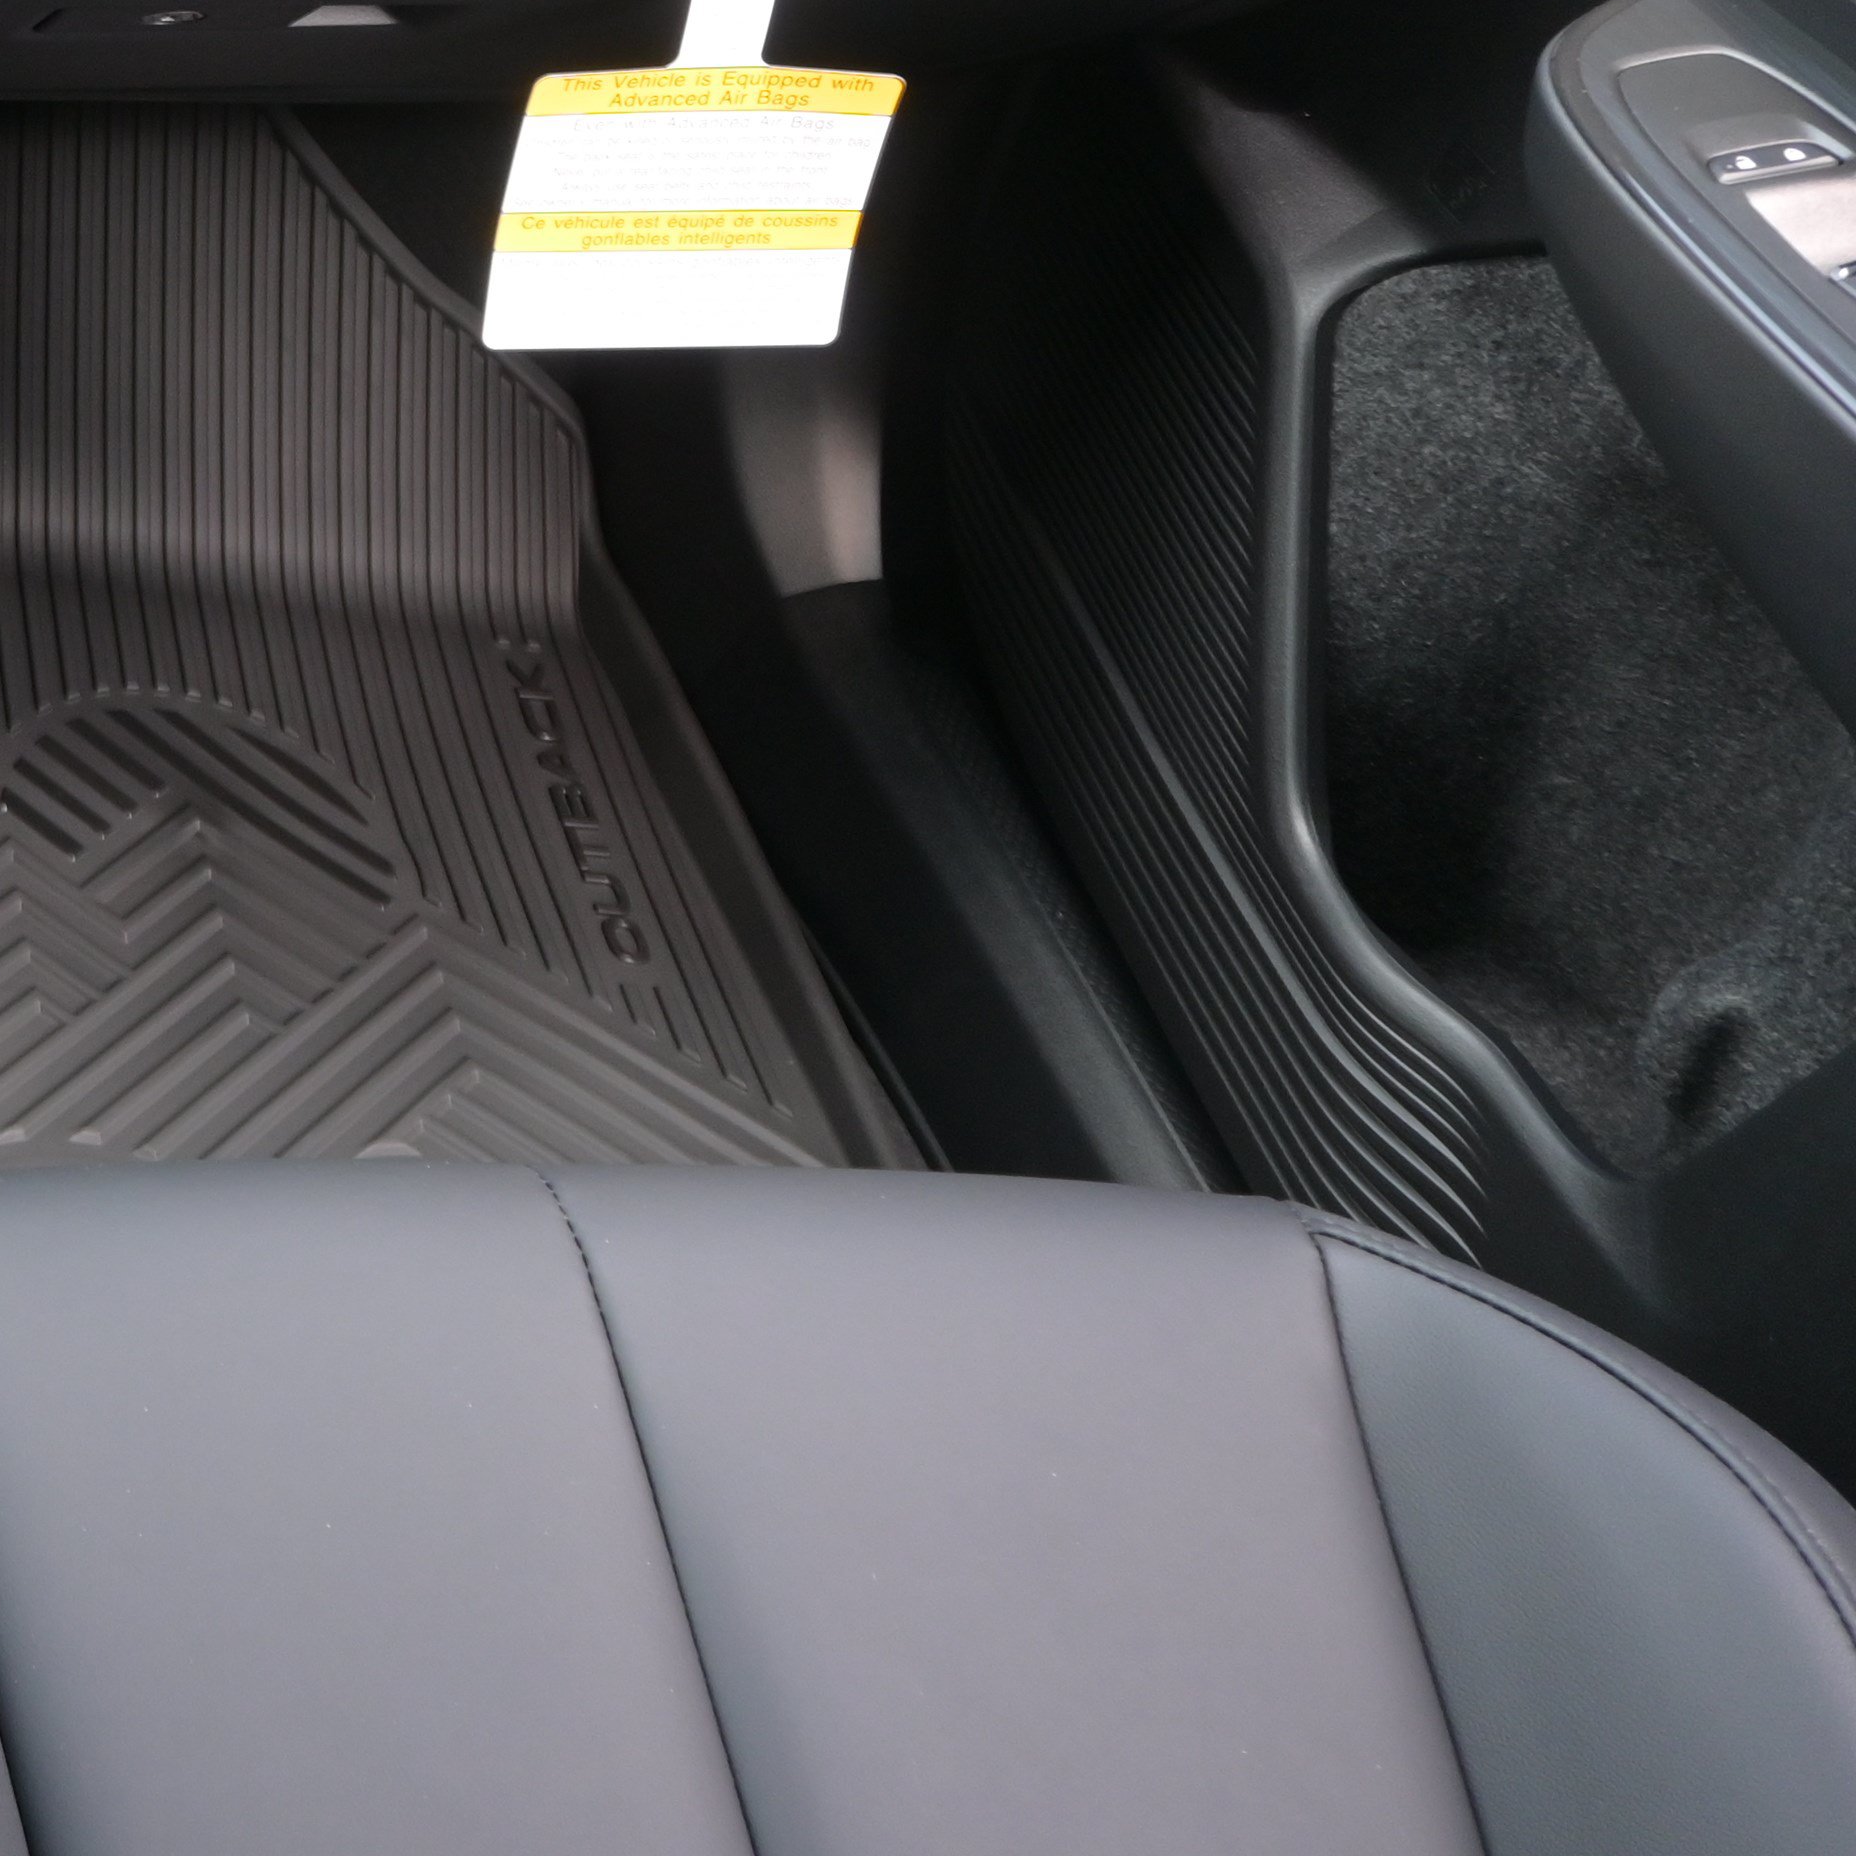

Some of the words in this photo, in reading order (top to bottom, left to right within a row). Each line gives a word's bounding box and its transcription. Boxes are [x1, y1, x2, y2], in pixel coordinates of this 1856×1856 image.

[562, 78, 604, 92] This
[613, 73, 686, 89] Vehicle
[695, 74, 712, 87] is
[722, 71, 823, 90] Equipped
[831, 76, 875, 92] with
[608, 90, 711, 108] Advanced
[719, 90, 748, 105] Air
[757, 89, 810, 109] Bags
[790, 116, 835, 132] Bags
[521, 215, 546, 230] Ce
[633, 215, 661, 229] est
[733, 214, 755, 228] de
[762, 215, 839, 228] coussins
[581, 231, 671, 250] gonflables
[678, 231, 772, 249] intelligents
[504, 658, 652, 964] OUTBACK
